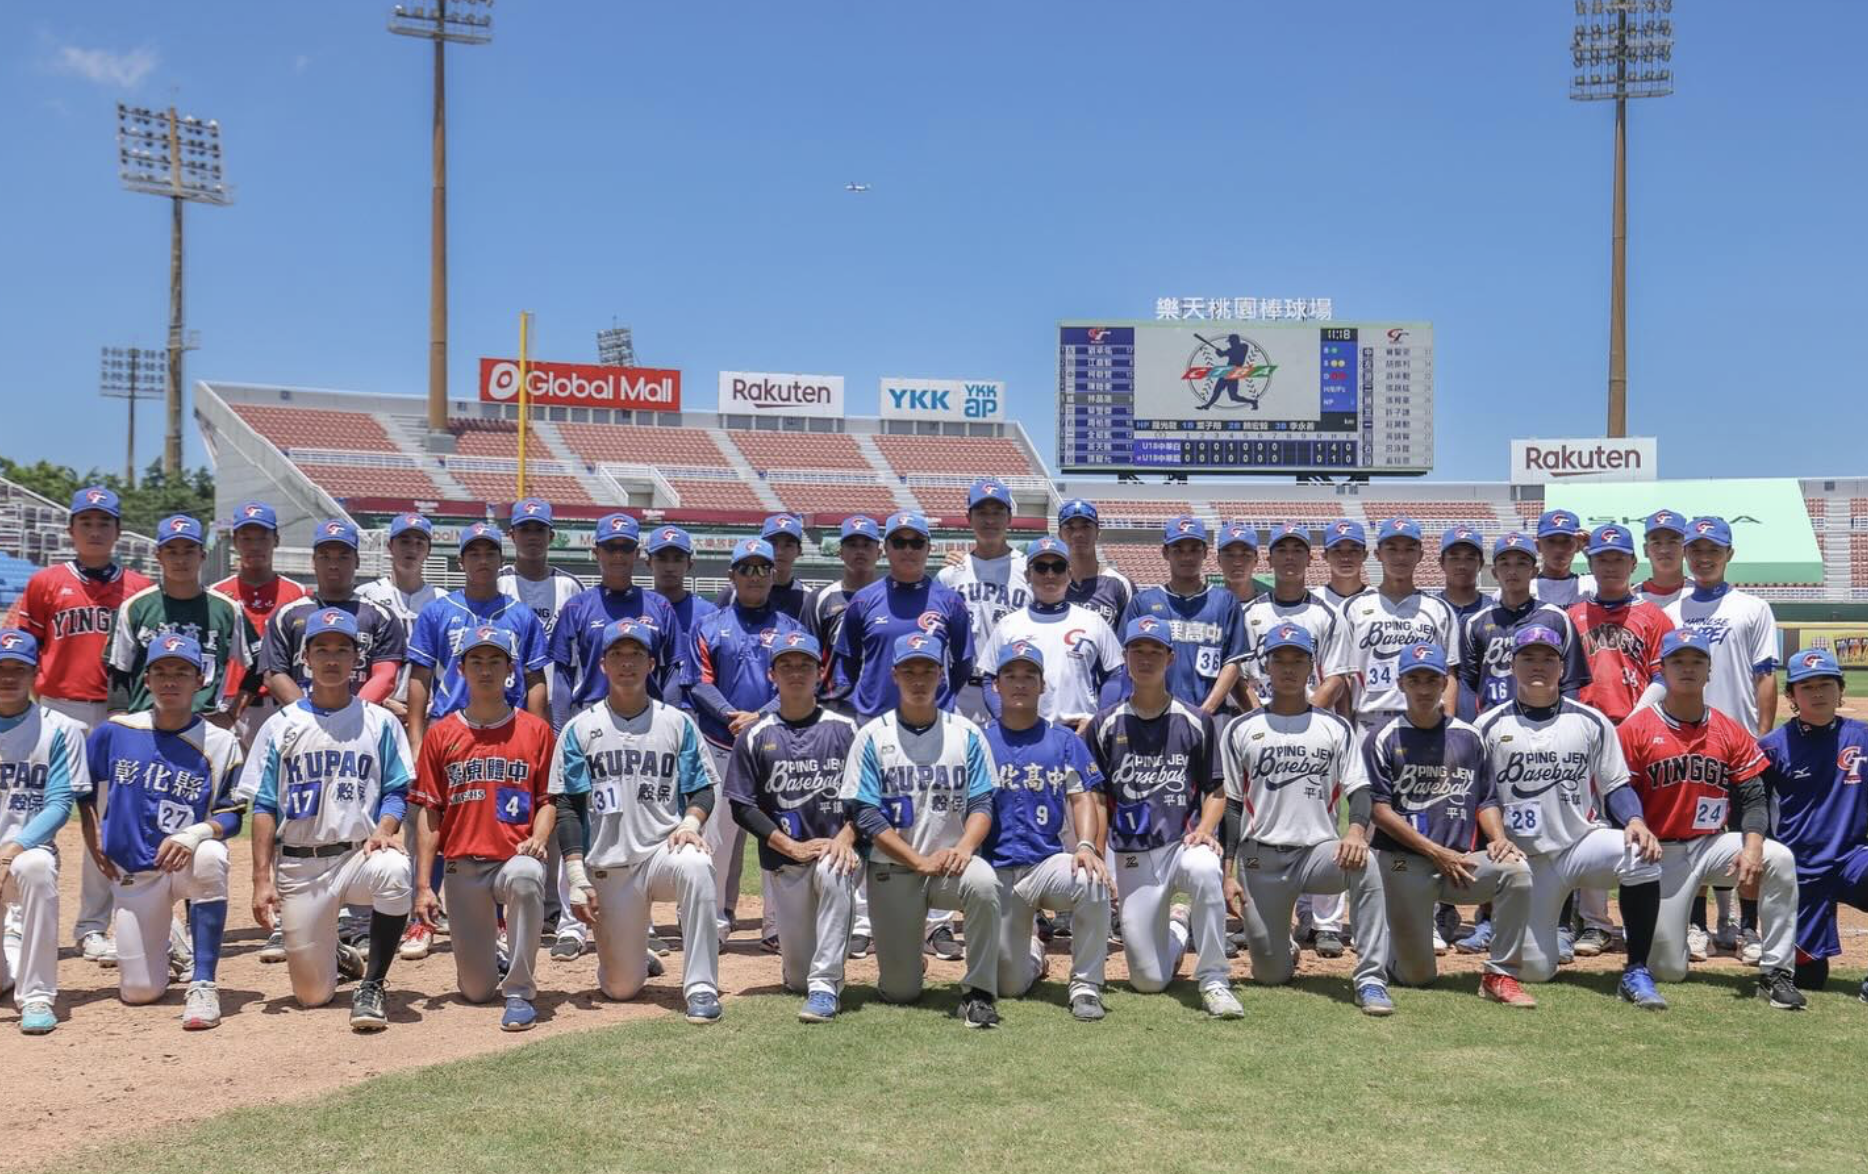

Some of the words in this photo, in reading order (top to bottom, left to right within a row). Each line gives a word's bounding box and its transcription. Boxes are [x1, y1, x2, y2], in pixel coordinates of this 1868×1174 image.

[1156, 297, 1332, 320] 樂天桃園棒球場
[1328, 330, 1350, 340] 11:18
[526, 370, 614, 400] Global
[620, 376, 673, 402] Mall
[732, 378, 831, 404] Rakuten
[964, 384, 997, 398] YKK
[889, 388, 950, 411] YKK
[964, 398, 997, 418] ap
[1184, 443, 1190, 451] 0
[1199, 443, 1205, 451] 0
[1213, 443, 1219, 451] 0
[1228, 443, 1234, 451] 1
[1243, 443, 1249, 451] 0
[1257, 443, 1263, 451] 0
[1271, 443, 1277, 451] 0
[1316, 443, 1322, 451] 1
[1331, 443, 1337, 451] 4
[1345, 443, 1351, 451] 0
[1525, 445, 1641, 469] Rakuten
[1384, 621, 1412, 631] PING
[1200, 652, 1220, 670] 36
[1370, 667, 1391, 684] 34
[1489, 682, 1507, 700] 16
[586, 749, 675, 780] KUPAO
[1135, 755, 1163, 767] PING
[1276, 746, 1306, 758] PING
[1311, 747, 1334, 762] JEN
[1526, 751, 1557, 764] PING
[1562, 752, 1588, 764] JEN
[283, 750, 372, 783] KUPAO
[788, 759, 818, 772] PING
[1418, 765, 1447, 777] PING
[1452, 767, 1475, 780] JEN
[1496, 752, 1588, 784] Baseball
[1646, 753, 1729, 791] YINGGE
[114, 758, 205, 801] 彰化縣
[879, 765, 967, 793] KUPAO
[1393, 764, 1474, 795] Baseball
[290, 791, 313, 814] 17
[594, 788, 616, 811] 31
[637, 783, 671, 804] 穀保
[505, 796, 519, 816] 4
[1035, 804, 1048, 826] 9
[1698, 804, 1721, 823] 24
[162, 806, 188, 829] 27
[1511, 810, 1537, 829] 28
